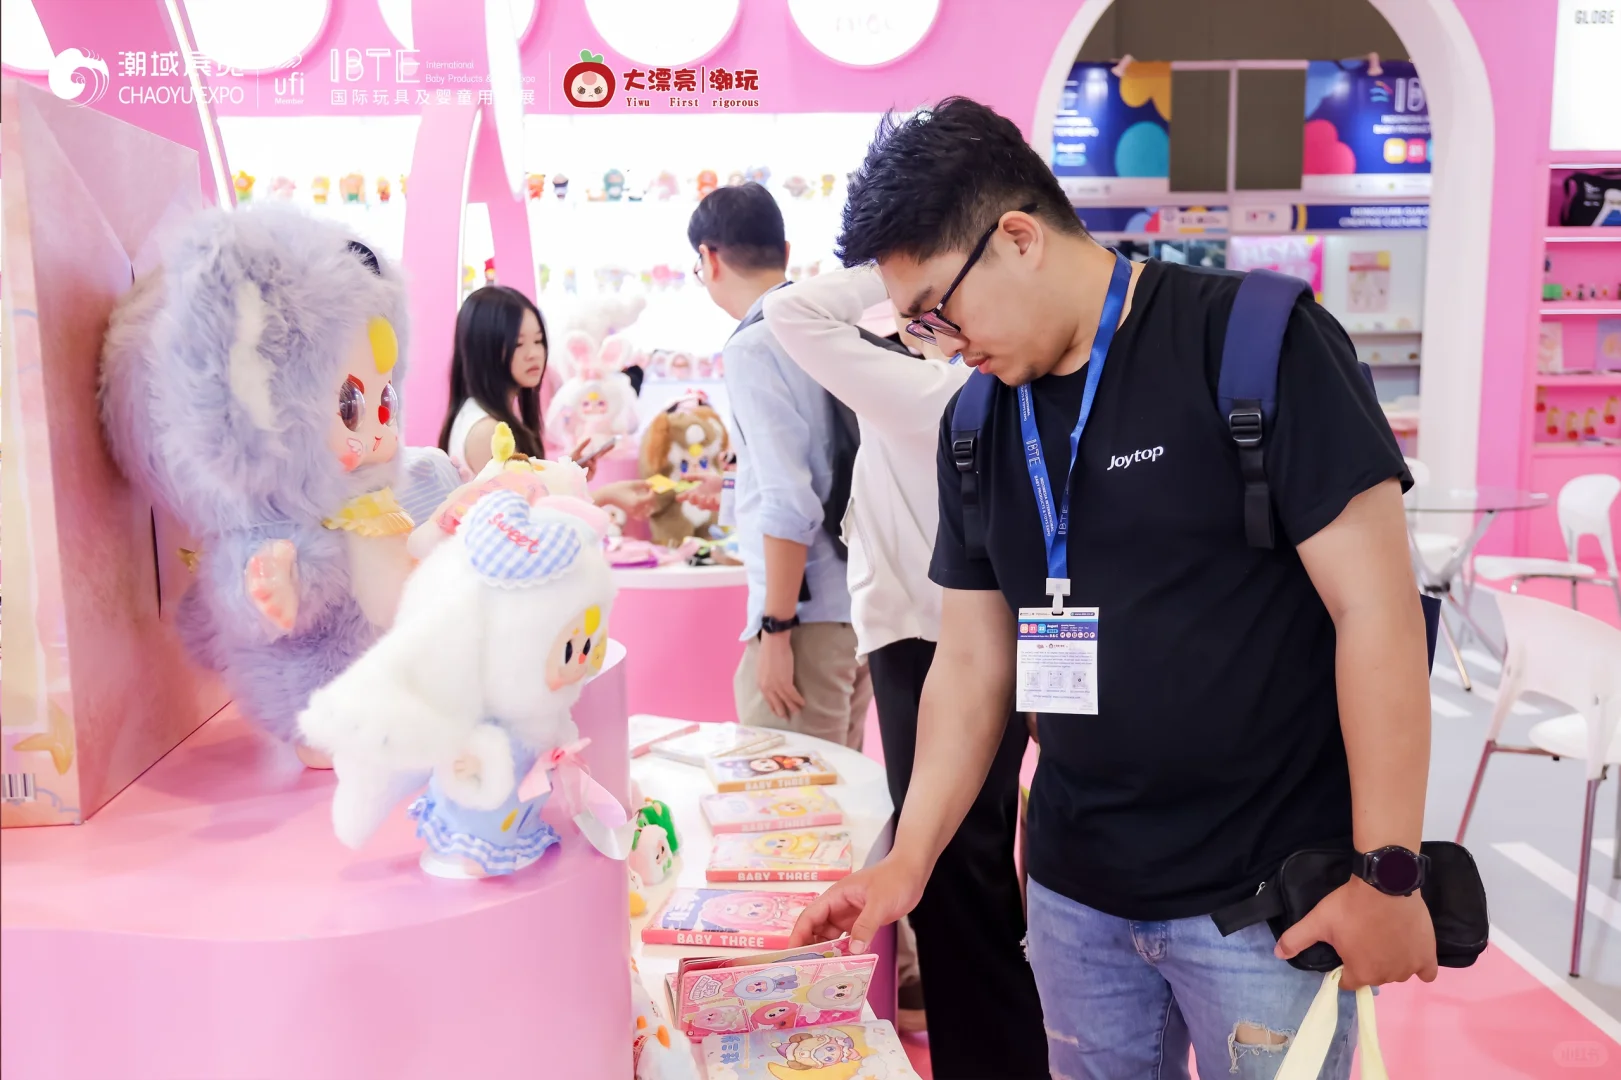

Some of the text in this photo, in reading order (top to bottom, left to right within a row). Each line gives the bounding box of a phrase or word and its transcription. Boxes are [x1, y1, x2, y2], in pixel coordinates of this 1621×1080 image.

[1026, 438, 1041, 467] IBTE
[1107, 445, 1164, 470] Joytop
[1058, 504, 1069, 535] IBTE
[744, 780, 772, 791] BABY
[737, 872, 818, 881] BABY THREE
[677, 933, 764, 947] BABY THREE
